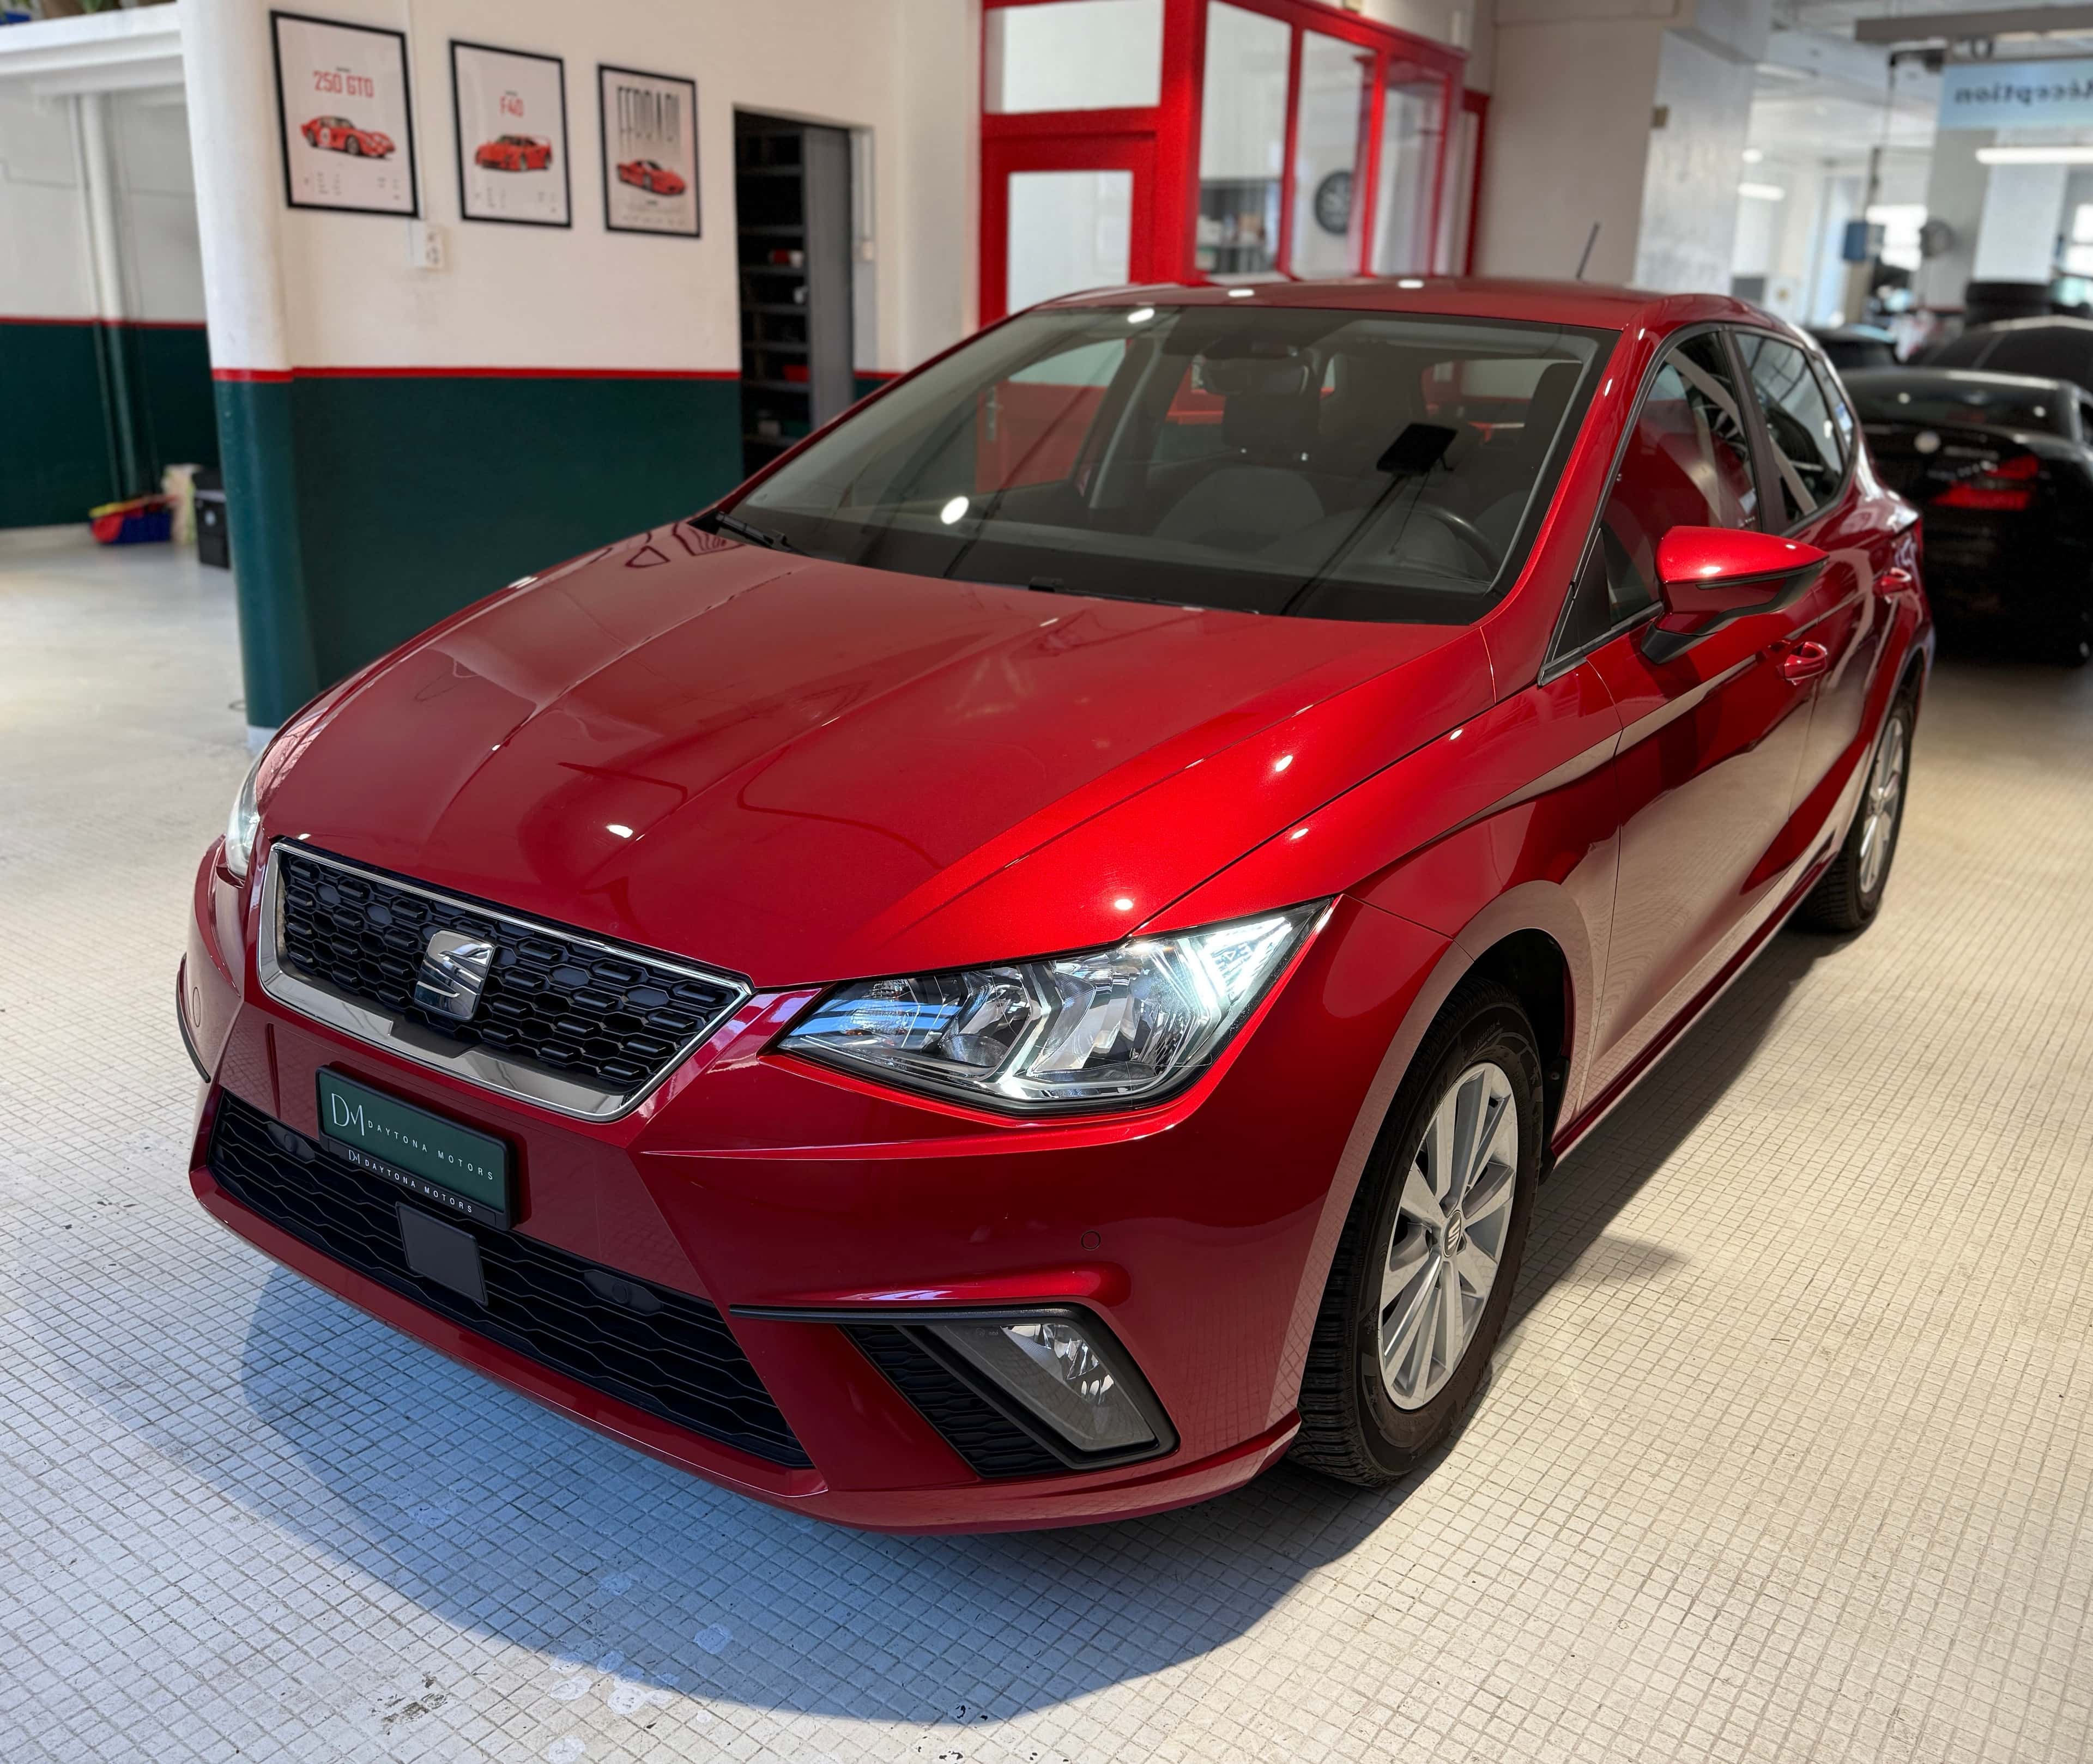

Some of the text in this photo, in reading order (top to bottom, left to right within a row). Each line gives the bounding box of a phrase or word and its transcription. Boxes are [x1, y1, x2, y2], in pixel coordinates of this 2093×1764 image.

[313, 70, 374, 98] 250 GTO
[368, 1120, 427, 1153] DAYTONA
[438, 1150, 493, 1180] MOTORS
[365, 1159, 416, 1188] DAYTONA
[424, 1186, 472, 1213] MOTORS
